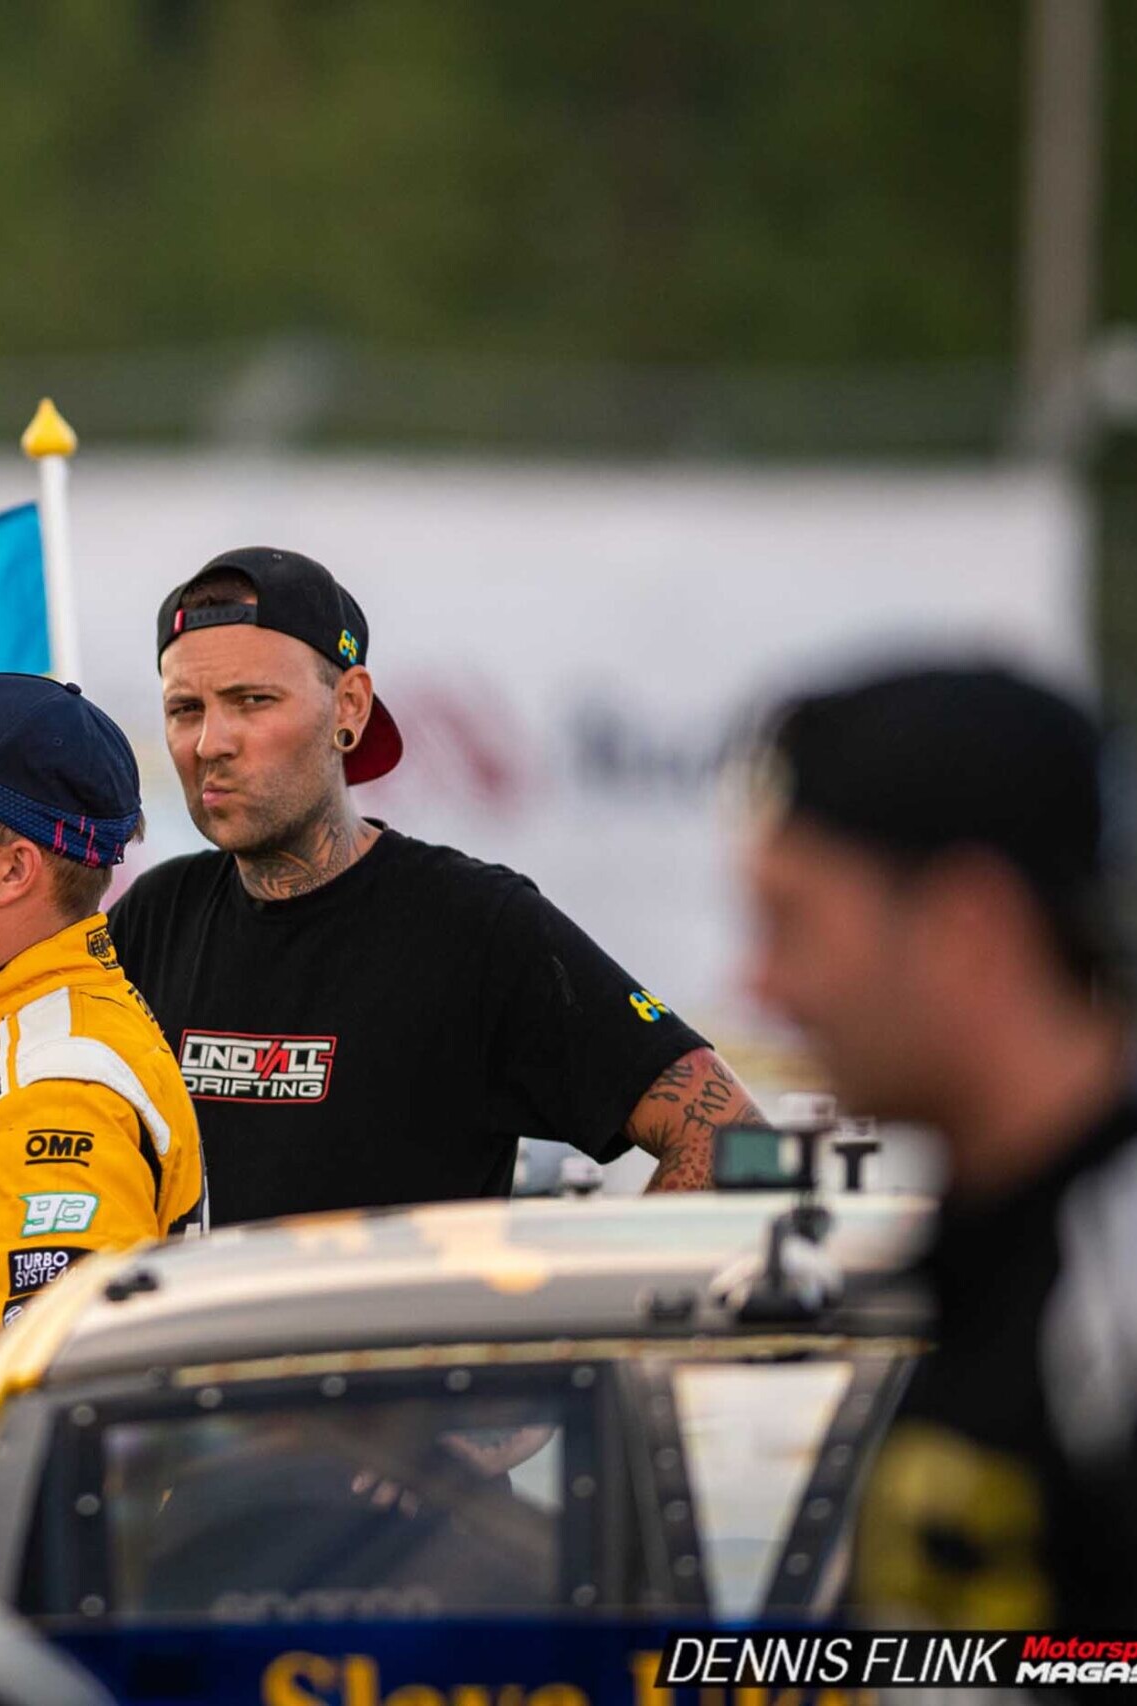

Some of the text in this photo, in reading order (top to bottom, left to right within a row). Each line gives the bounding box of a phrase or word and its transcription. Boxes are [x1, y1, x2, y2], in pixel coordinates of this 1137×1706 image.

[181, 1040, 327, 1080] LINDVALL
[184, 1076, 324, 1098] DRIFTING
[25, 1135, 94, 1157] OMP
[19, 1191, 101, 1238] 93
[14, 1251, 69, 1271] TURBO
